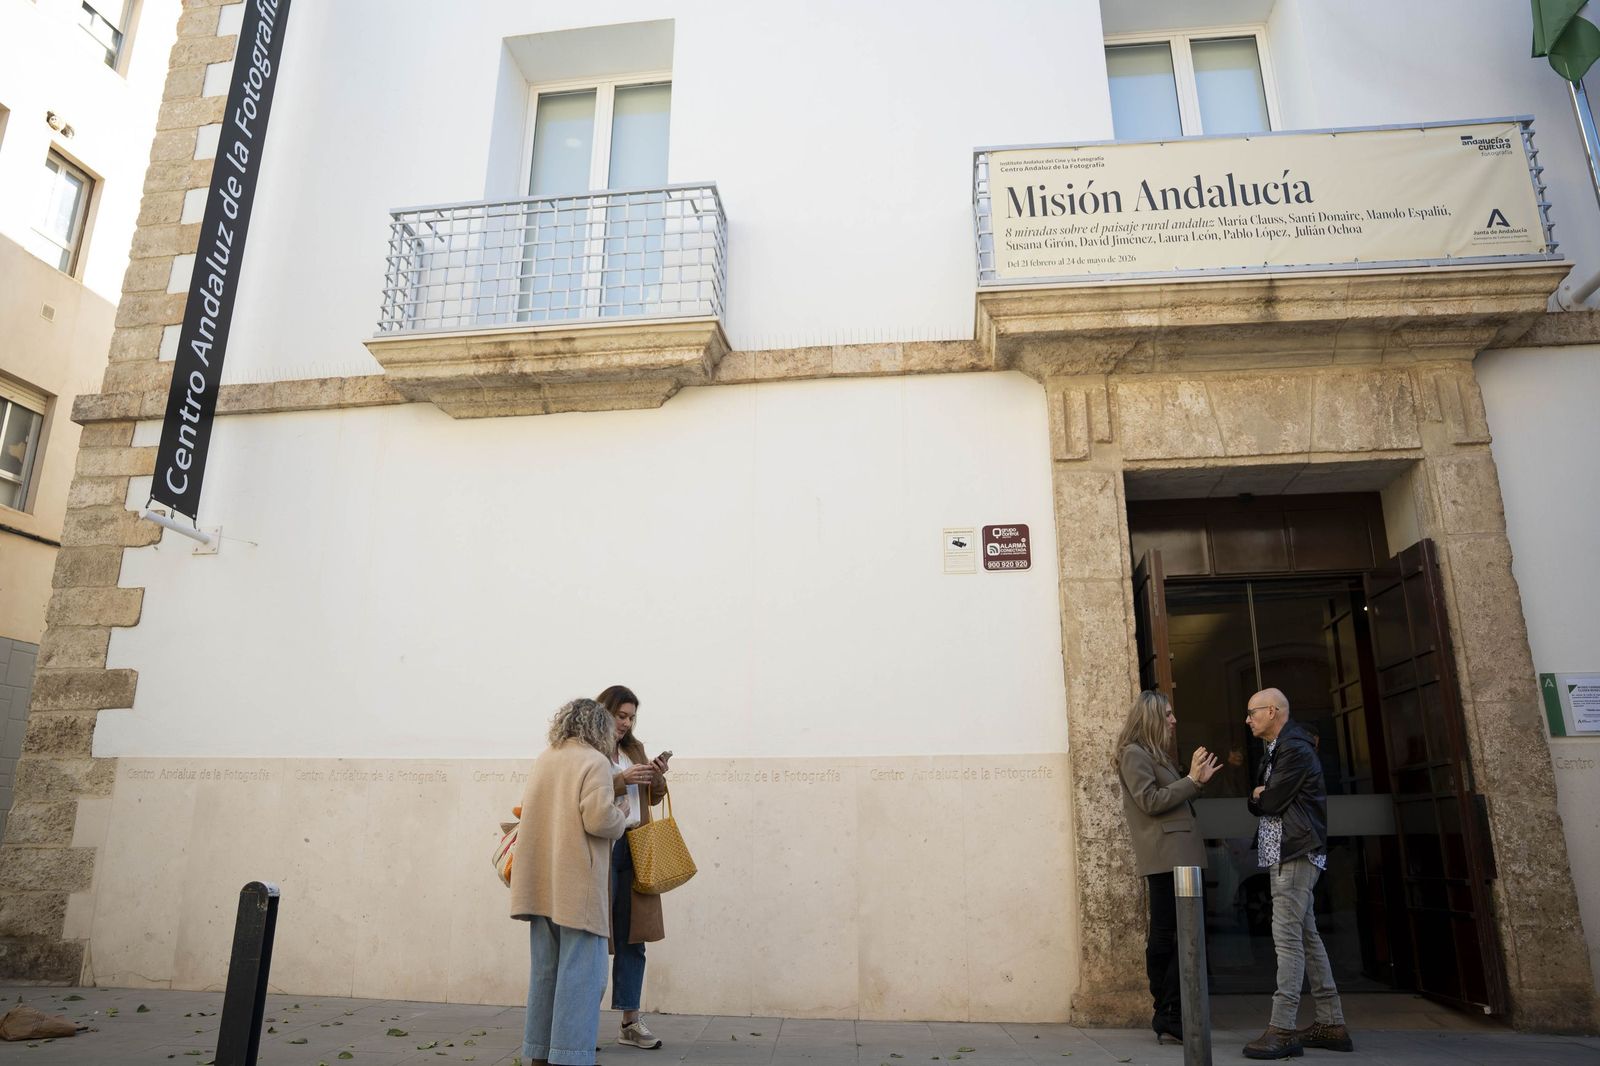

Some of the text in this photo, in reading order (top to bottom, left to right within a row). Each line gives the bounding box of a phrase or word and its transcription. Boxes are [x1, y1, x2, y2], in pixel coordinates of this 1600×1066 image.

[1478, 143, 1511, 151] cultura
[226, 140, 249, 174] la
[219, 176, 242, 220] de
[1005, 169, 1315, 218] Misión Andalucía
[1005, 204, 1452, 238] 8 miradas sobre el paisaje rural andaluz María Clauss, Santi Donaire, Manolo Espaliú,
[1006, 223, 1363, 251] Susana Girón, David Jiménez, Laura León, Pablo López, Julián Ochoa
[1030, 259, 1056, 267] febrero
[1058, 258, 1065, 266] al
[1076, 257, 1086, 265] de
[1086, 257, 1106, 266] mayo
[1118, 255, 1137, 263] 2026
[190, 221, 234, 367] Andaluz
[166, 370, 206, 495] Centro
[1556, 756, 1595, 770] Centro
[127, 768, 155, 780] Centro
[160, 768, 196, 780] Andaluz
[200, 768, 211, 780] de
[213, 768, 221, 780] la
[295, 769, 323, 781] Centro
[328, 769, 368, 782] Andaluz
[371, 769, 384, 782] de
[386, 769, 393, 782] la
[473, 770, 505, 782] Centro
[667, 769, 841, 784] Centro Andaluz de la Fotografía
[870, 766, 1053, 782] Centro Andaluz de la Fotografía
